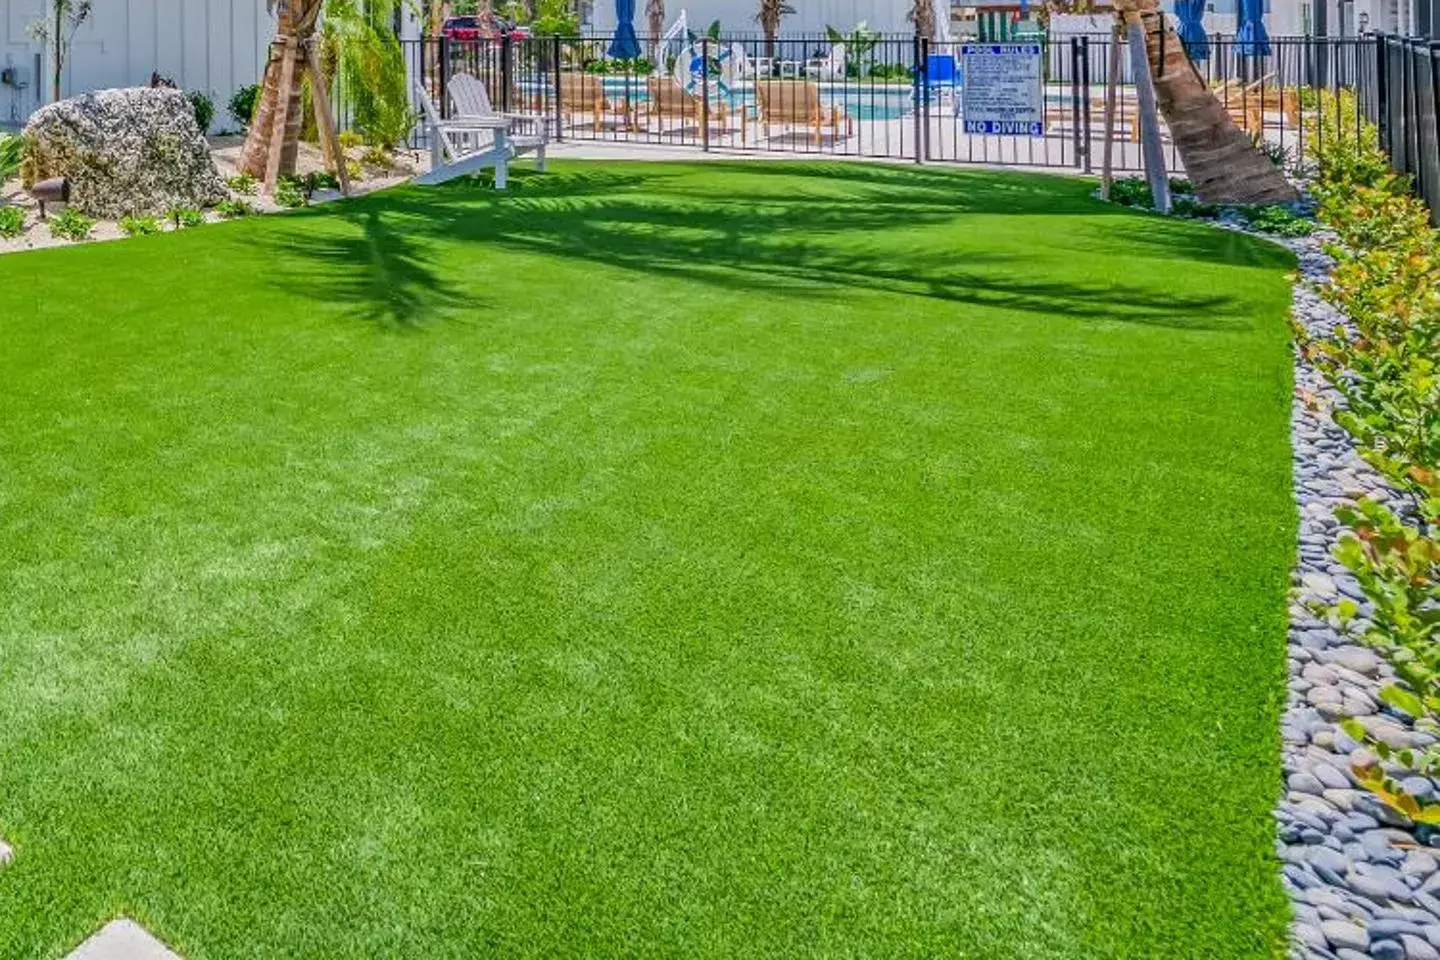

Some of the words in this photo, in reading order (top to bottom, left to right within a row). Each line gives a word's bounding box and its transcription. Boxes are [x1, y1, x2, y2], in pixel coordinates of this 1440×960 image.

[967, 44, 994, 55] POOL
[1000, 44, 1034, 55] RULES
[967, 121, 986, 133] NO
[992, 121, 1040, 135] DIVING
